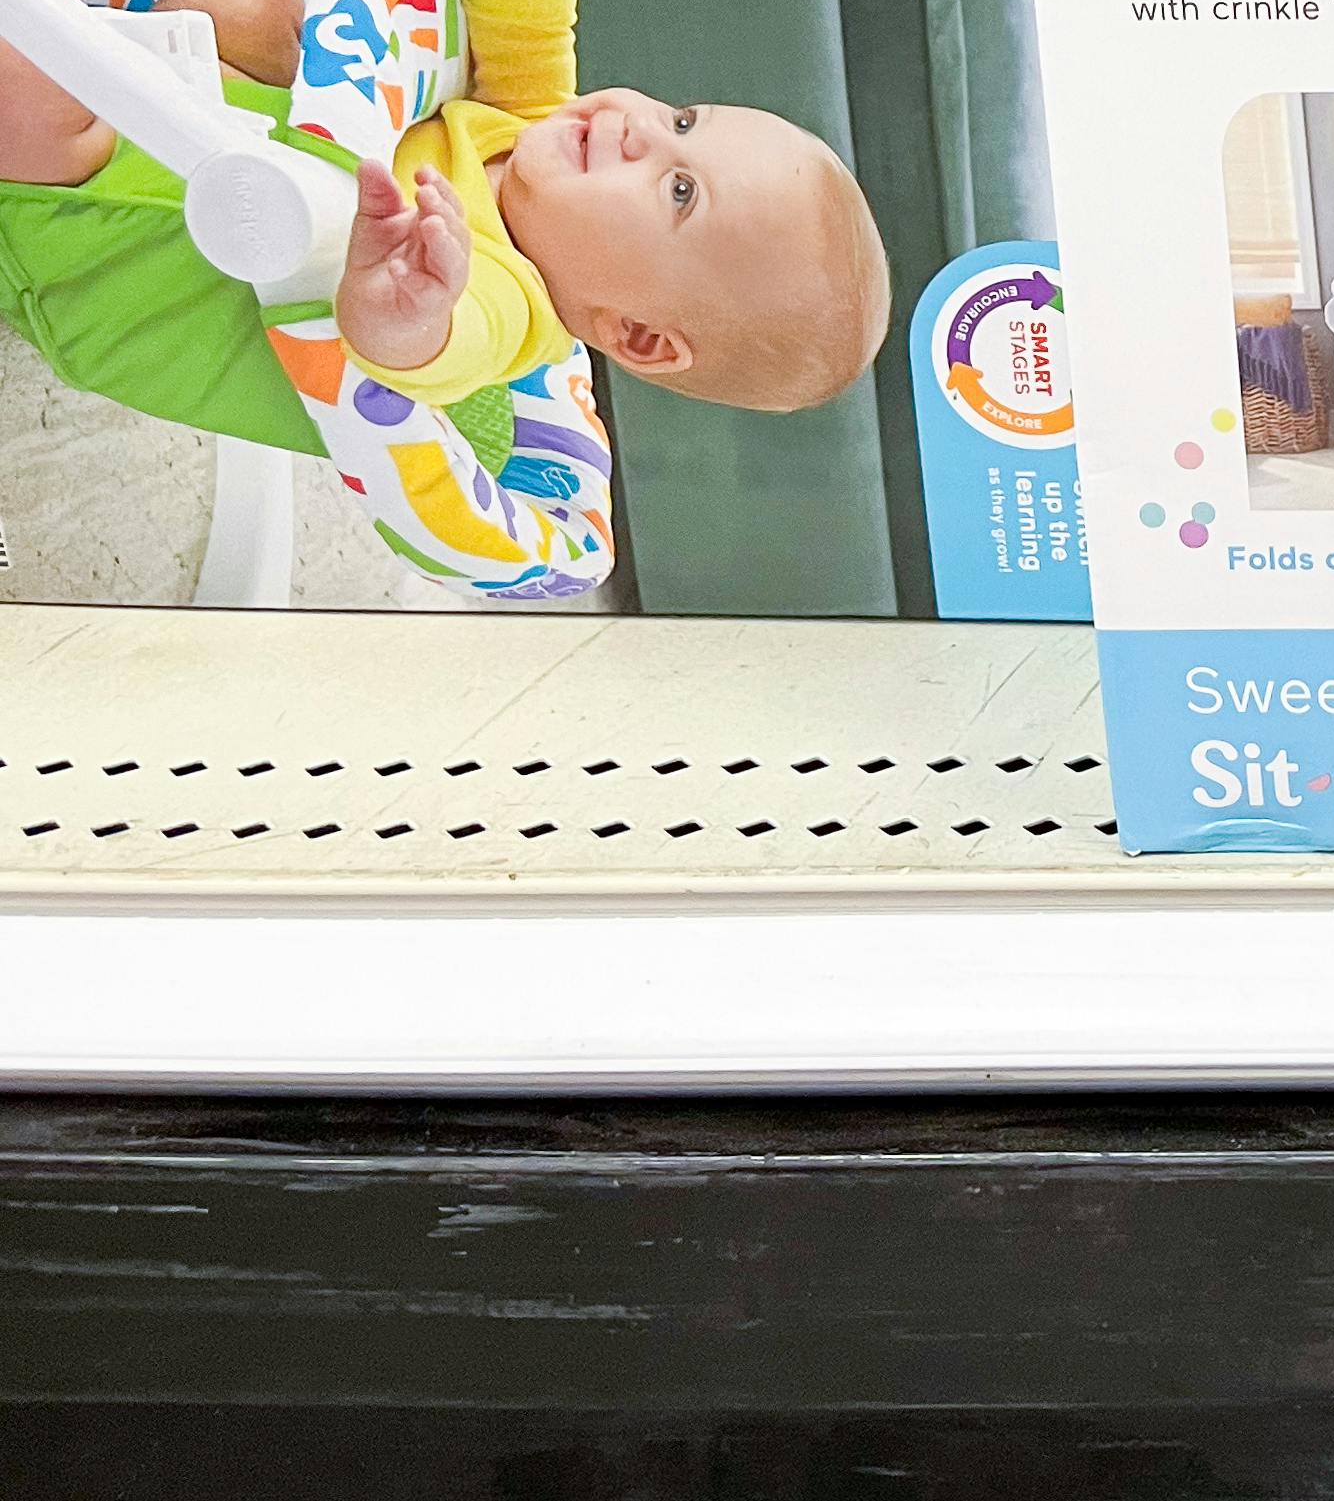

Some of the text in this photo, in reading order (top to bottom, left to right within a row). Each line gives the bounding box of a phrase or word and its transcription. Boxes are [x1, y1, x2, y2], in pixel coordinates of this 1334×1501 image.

[954, 284, 1018, 342] ENCOURAGE
[1008, 321, 1030, 395] STAGES
[1030, 321, 1053, 397] SMART
[981, 400, 1043, 430] EXPLORE
[987, 467, 1014, 574] as they grow!
[1014, 469, 1042, 573] learning
[1041, 482, 1071, 562] up the
[1227, 544, 1314, 571] Folds
